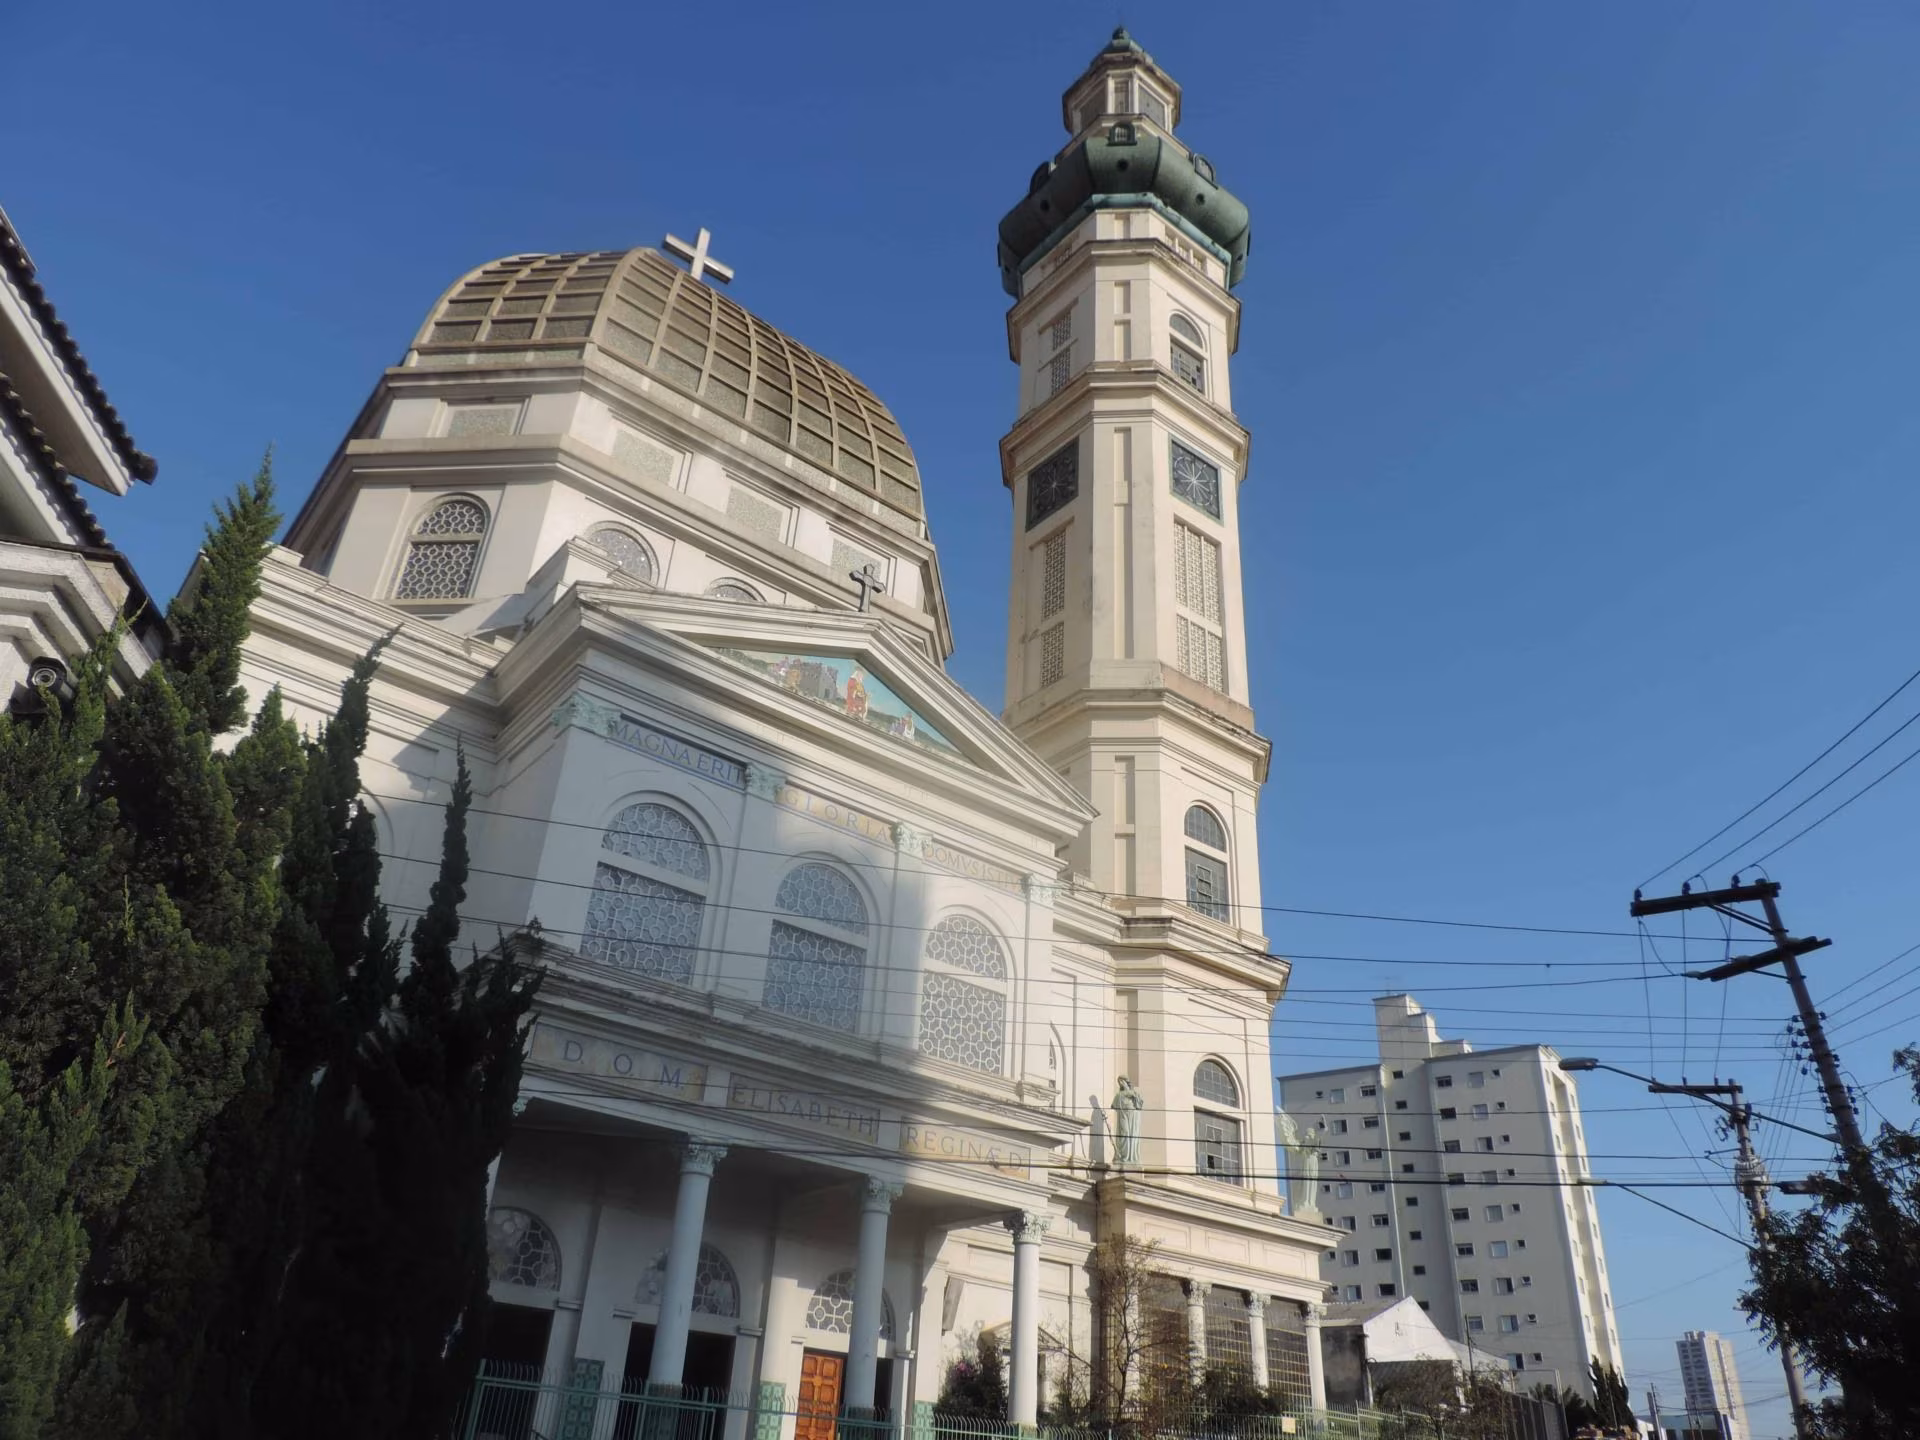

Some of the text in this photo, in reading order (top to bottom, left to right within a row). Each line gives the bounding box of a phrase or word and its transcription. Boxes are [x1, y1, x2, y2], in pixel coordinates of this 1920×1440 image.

[611, 719, 690, 766] MAGNA
[697, 752, 744, 784] ERIT
[784, 789, 889, 842] GLORIA
[733, 1084, 873, 1137] ELISABETH
